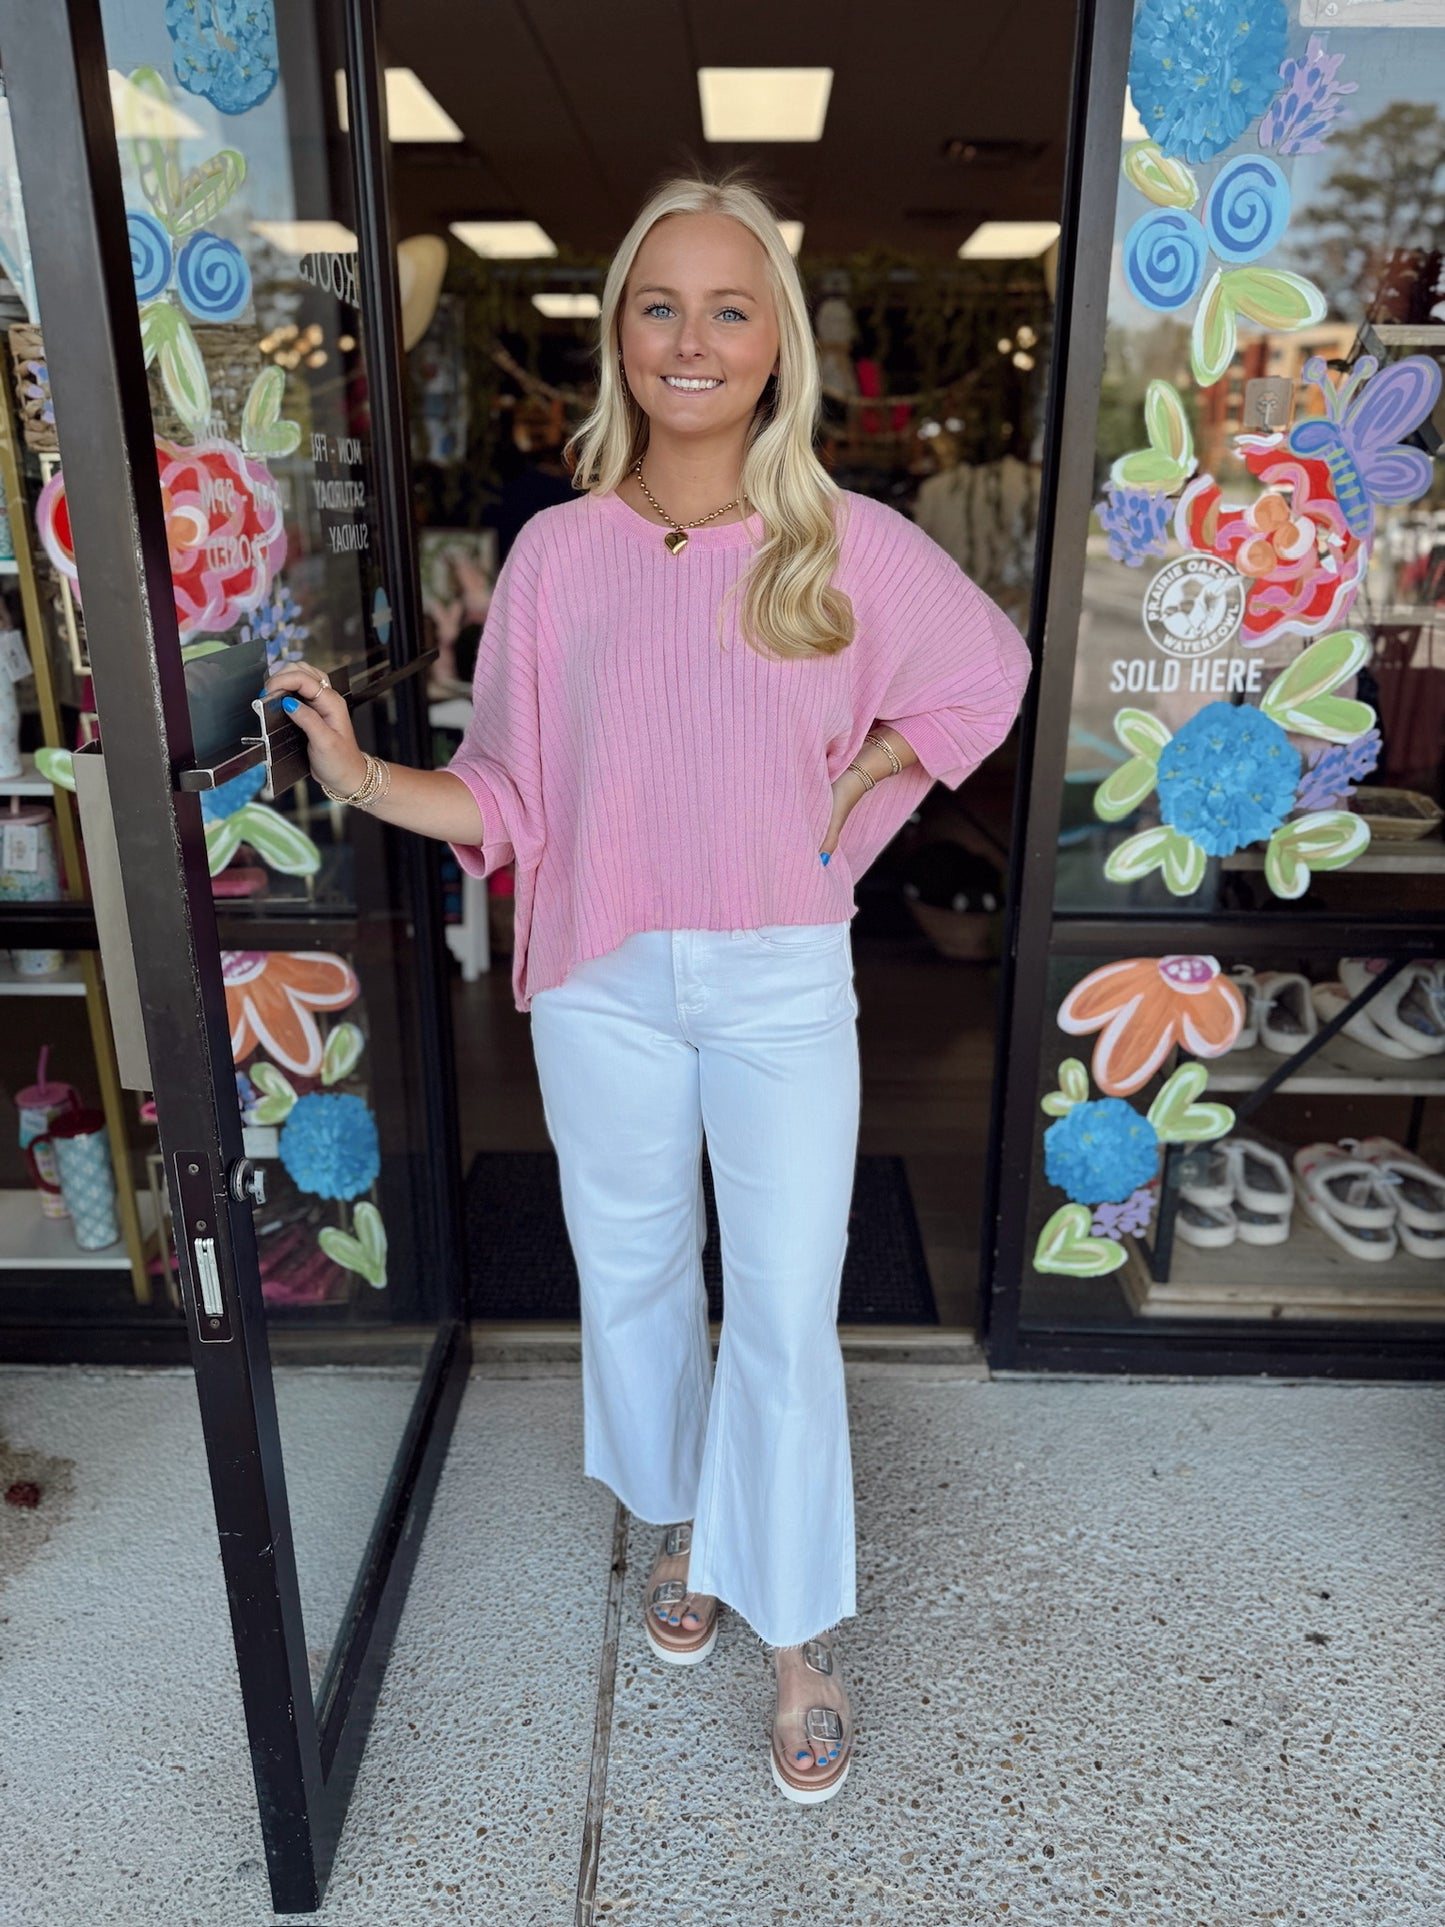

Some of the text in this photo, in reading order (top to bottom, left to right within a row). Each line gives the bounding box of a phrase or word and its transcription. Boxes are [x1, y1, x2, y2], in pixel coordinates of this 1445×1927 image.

[1148, 559, 1229, 622] PRAIRIE OAKS
[1162, 603, 1240, 653] WATERFOWL
[1109, 658, 1265, 693] SOLD HERE
